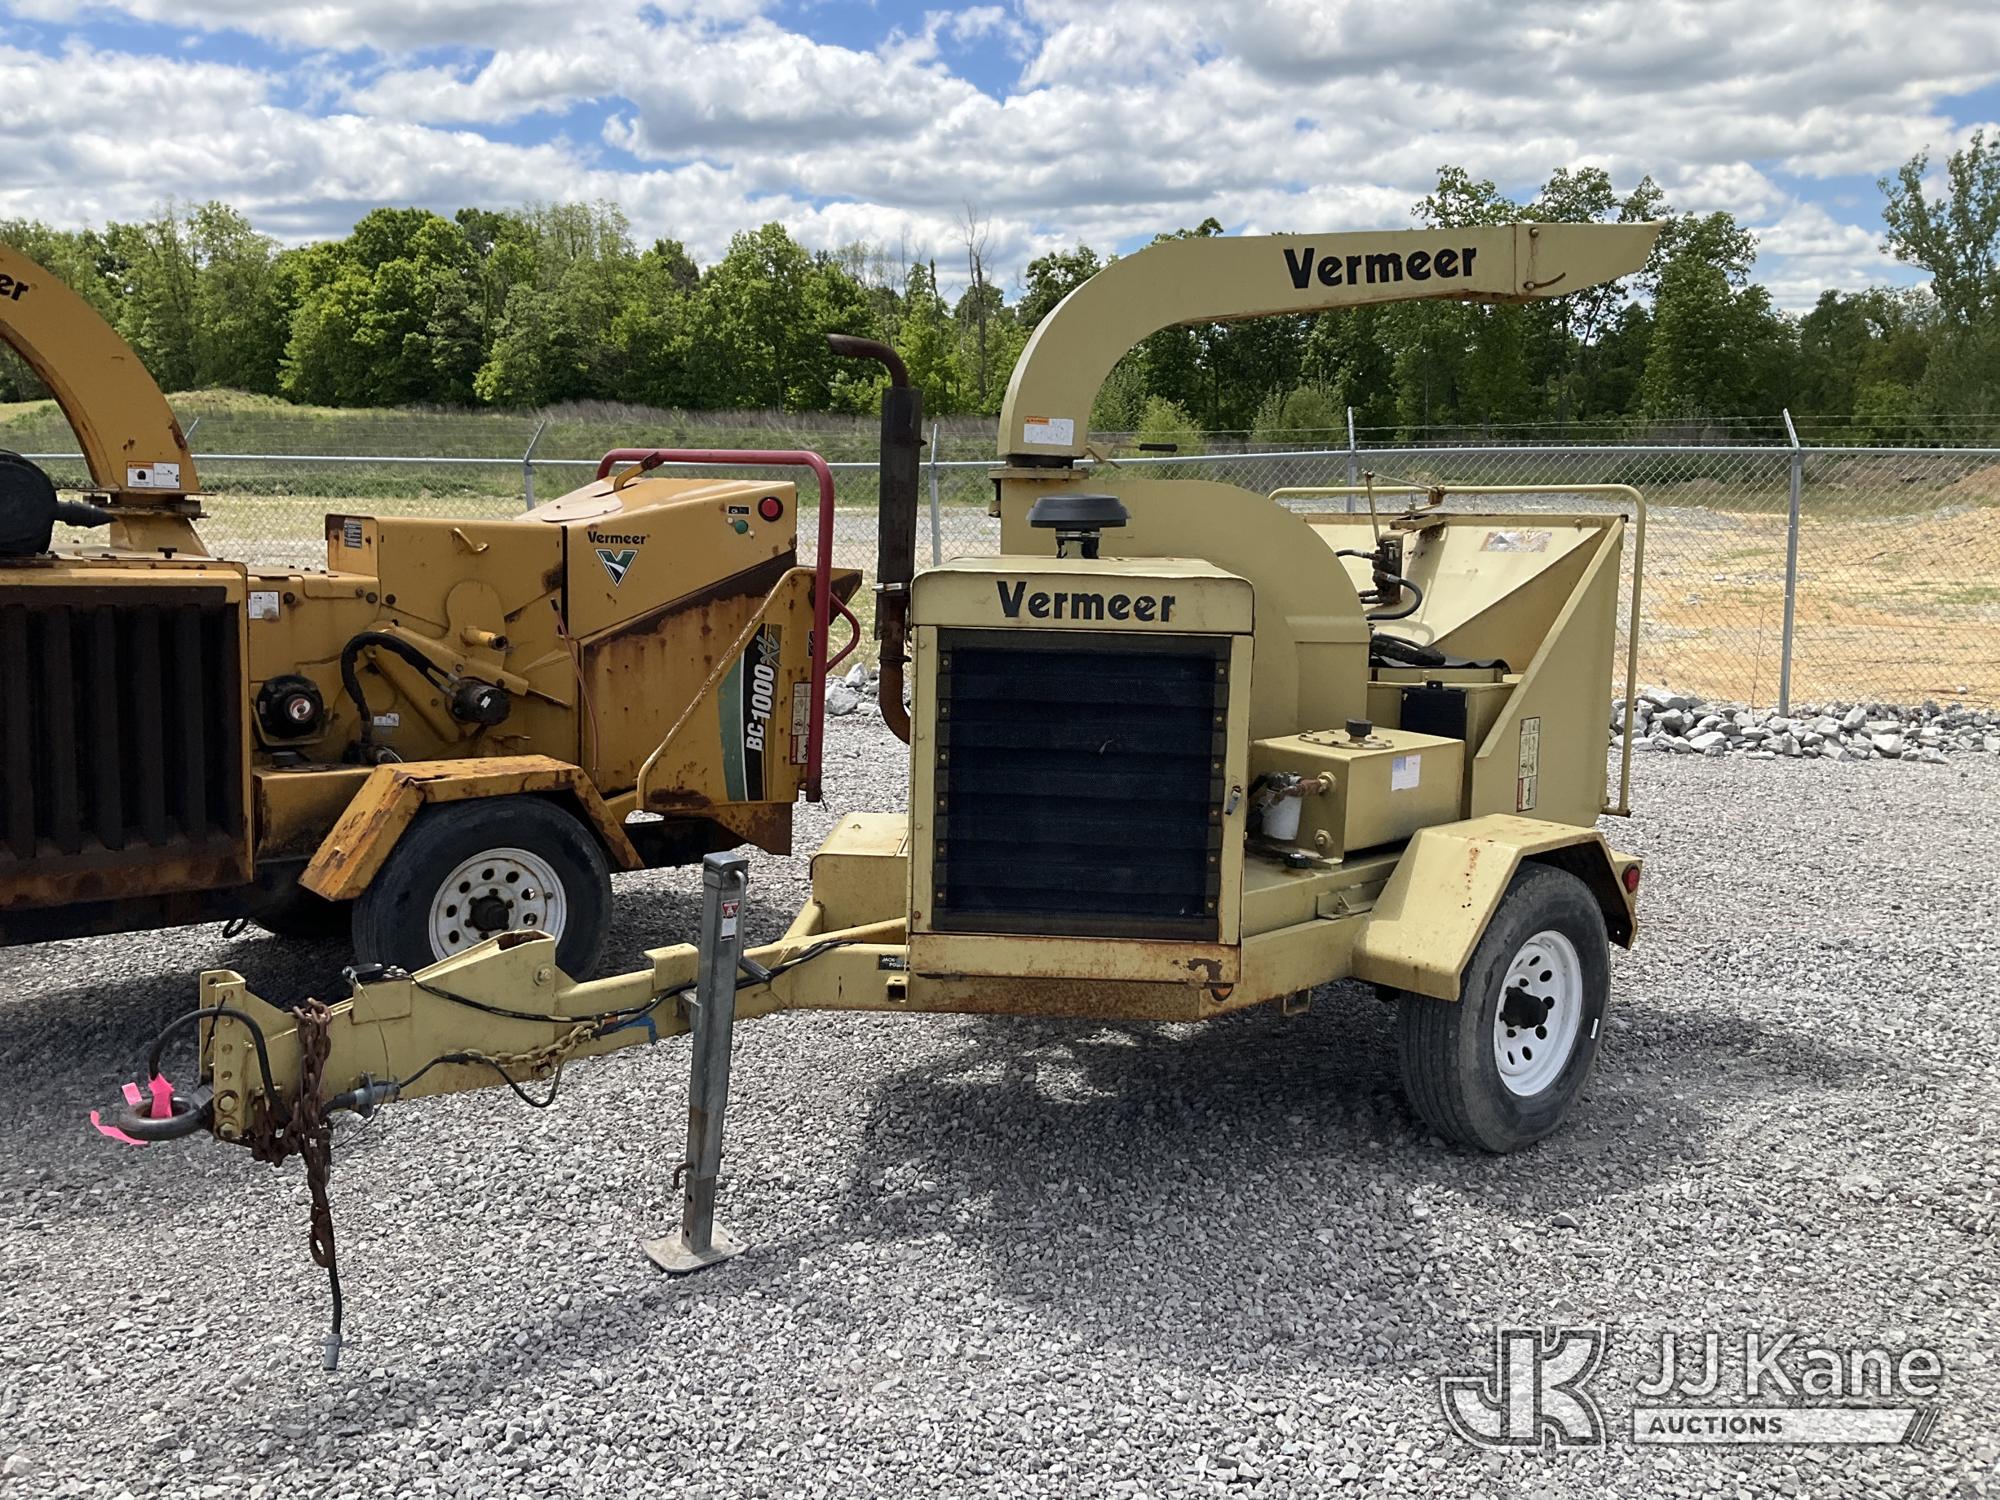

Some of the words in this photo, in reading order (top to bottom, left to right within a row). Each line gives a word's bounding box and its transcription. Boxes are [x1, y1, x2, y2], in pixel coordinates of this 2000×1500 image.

[1283, 247, 1477, 289] Vermeer
[587, 530, 647, 545] Vermeer
[996, 580, 1176, 622] Vermeer
